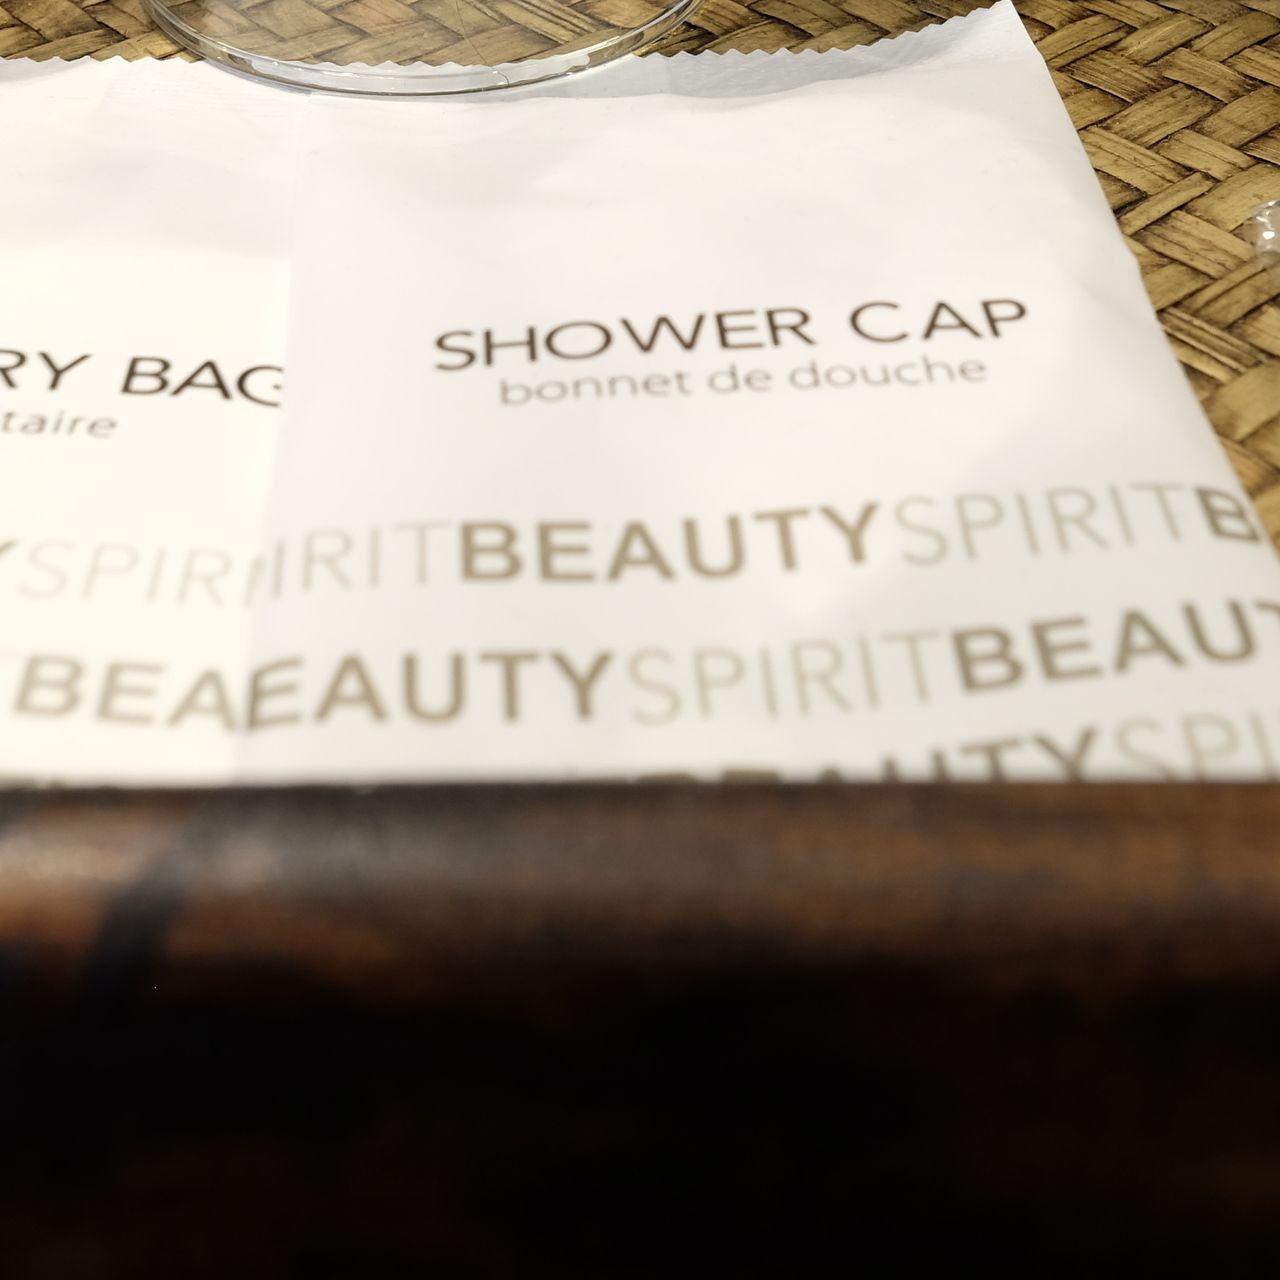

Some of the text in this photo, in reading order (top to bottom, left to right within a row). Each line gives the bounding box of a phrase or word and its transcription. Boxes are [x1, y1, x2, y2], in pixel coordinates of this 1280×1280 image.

[433, 298, 1028, 373] SHOWER CAP
[500, 354, 987, 408] bonnet de douche
